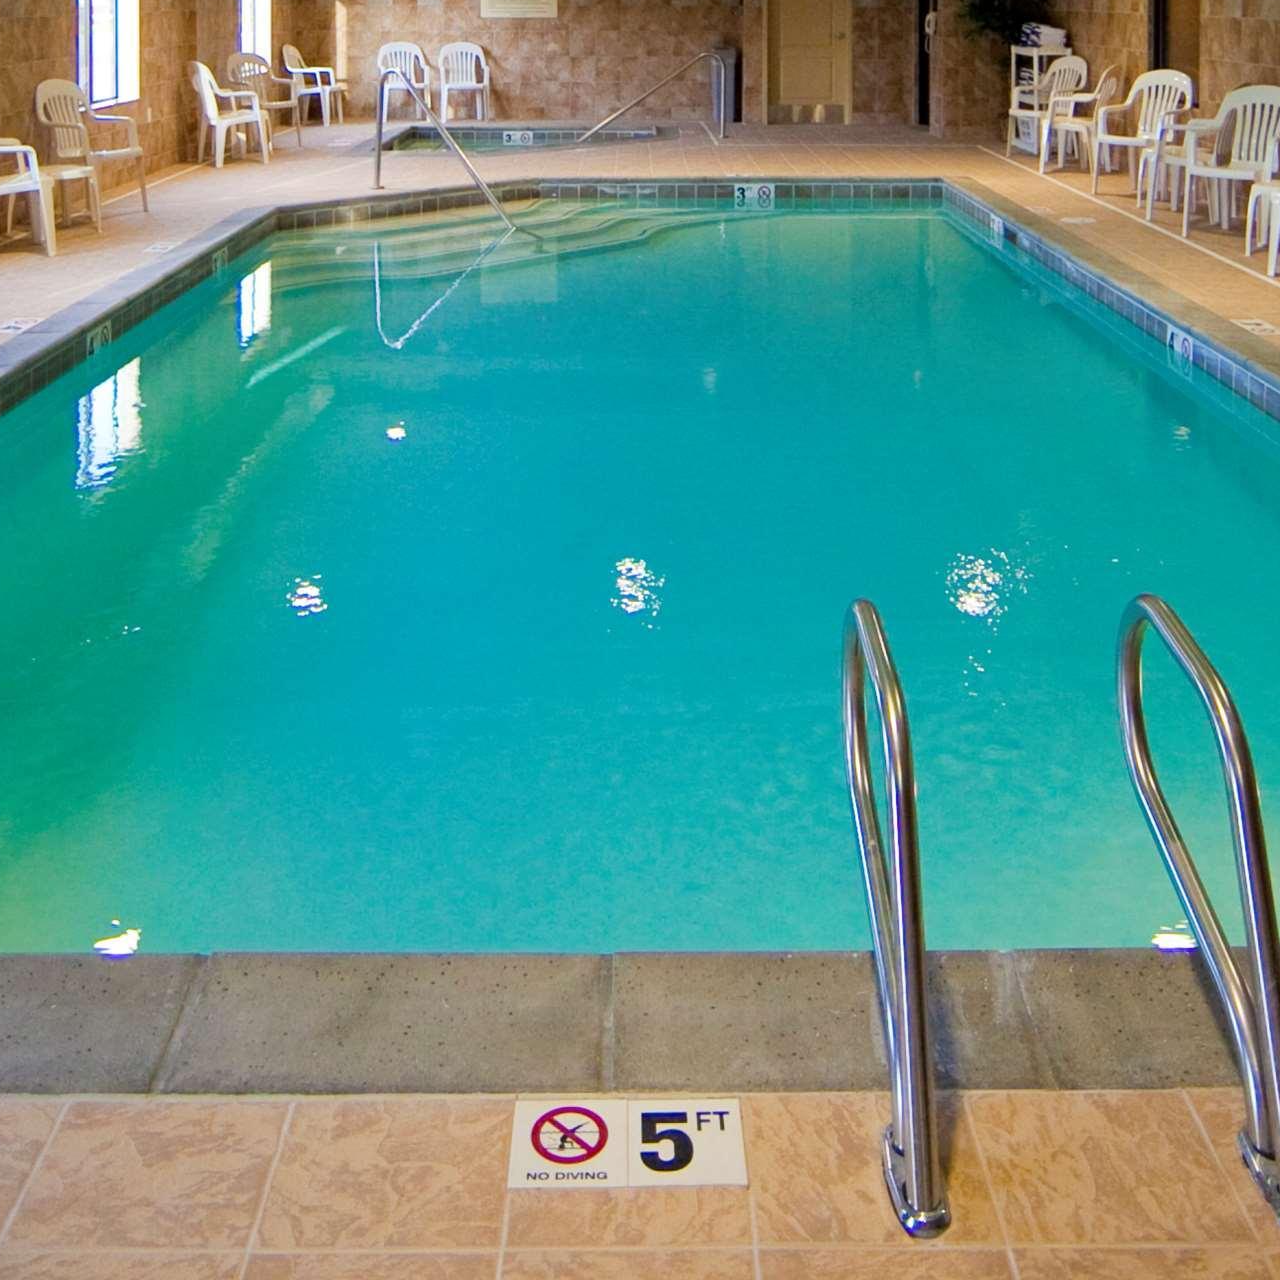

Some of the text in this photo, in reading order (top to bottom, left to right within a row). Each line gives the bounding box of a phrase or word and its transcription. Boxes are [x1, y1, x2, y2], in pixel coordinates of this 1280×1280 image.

[505, 133, 512, 143] 3
[736, 186, 746, 199] 3
[639, 1111, 730, 1172] 5 FT
[526, 1171, 608, 1181] NO DIVING
